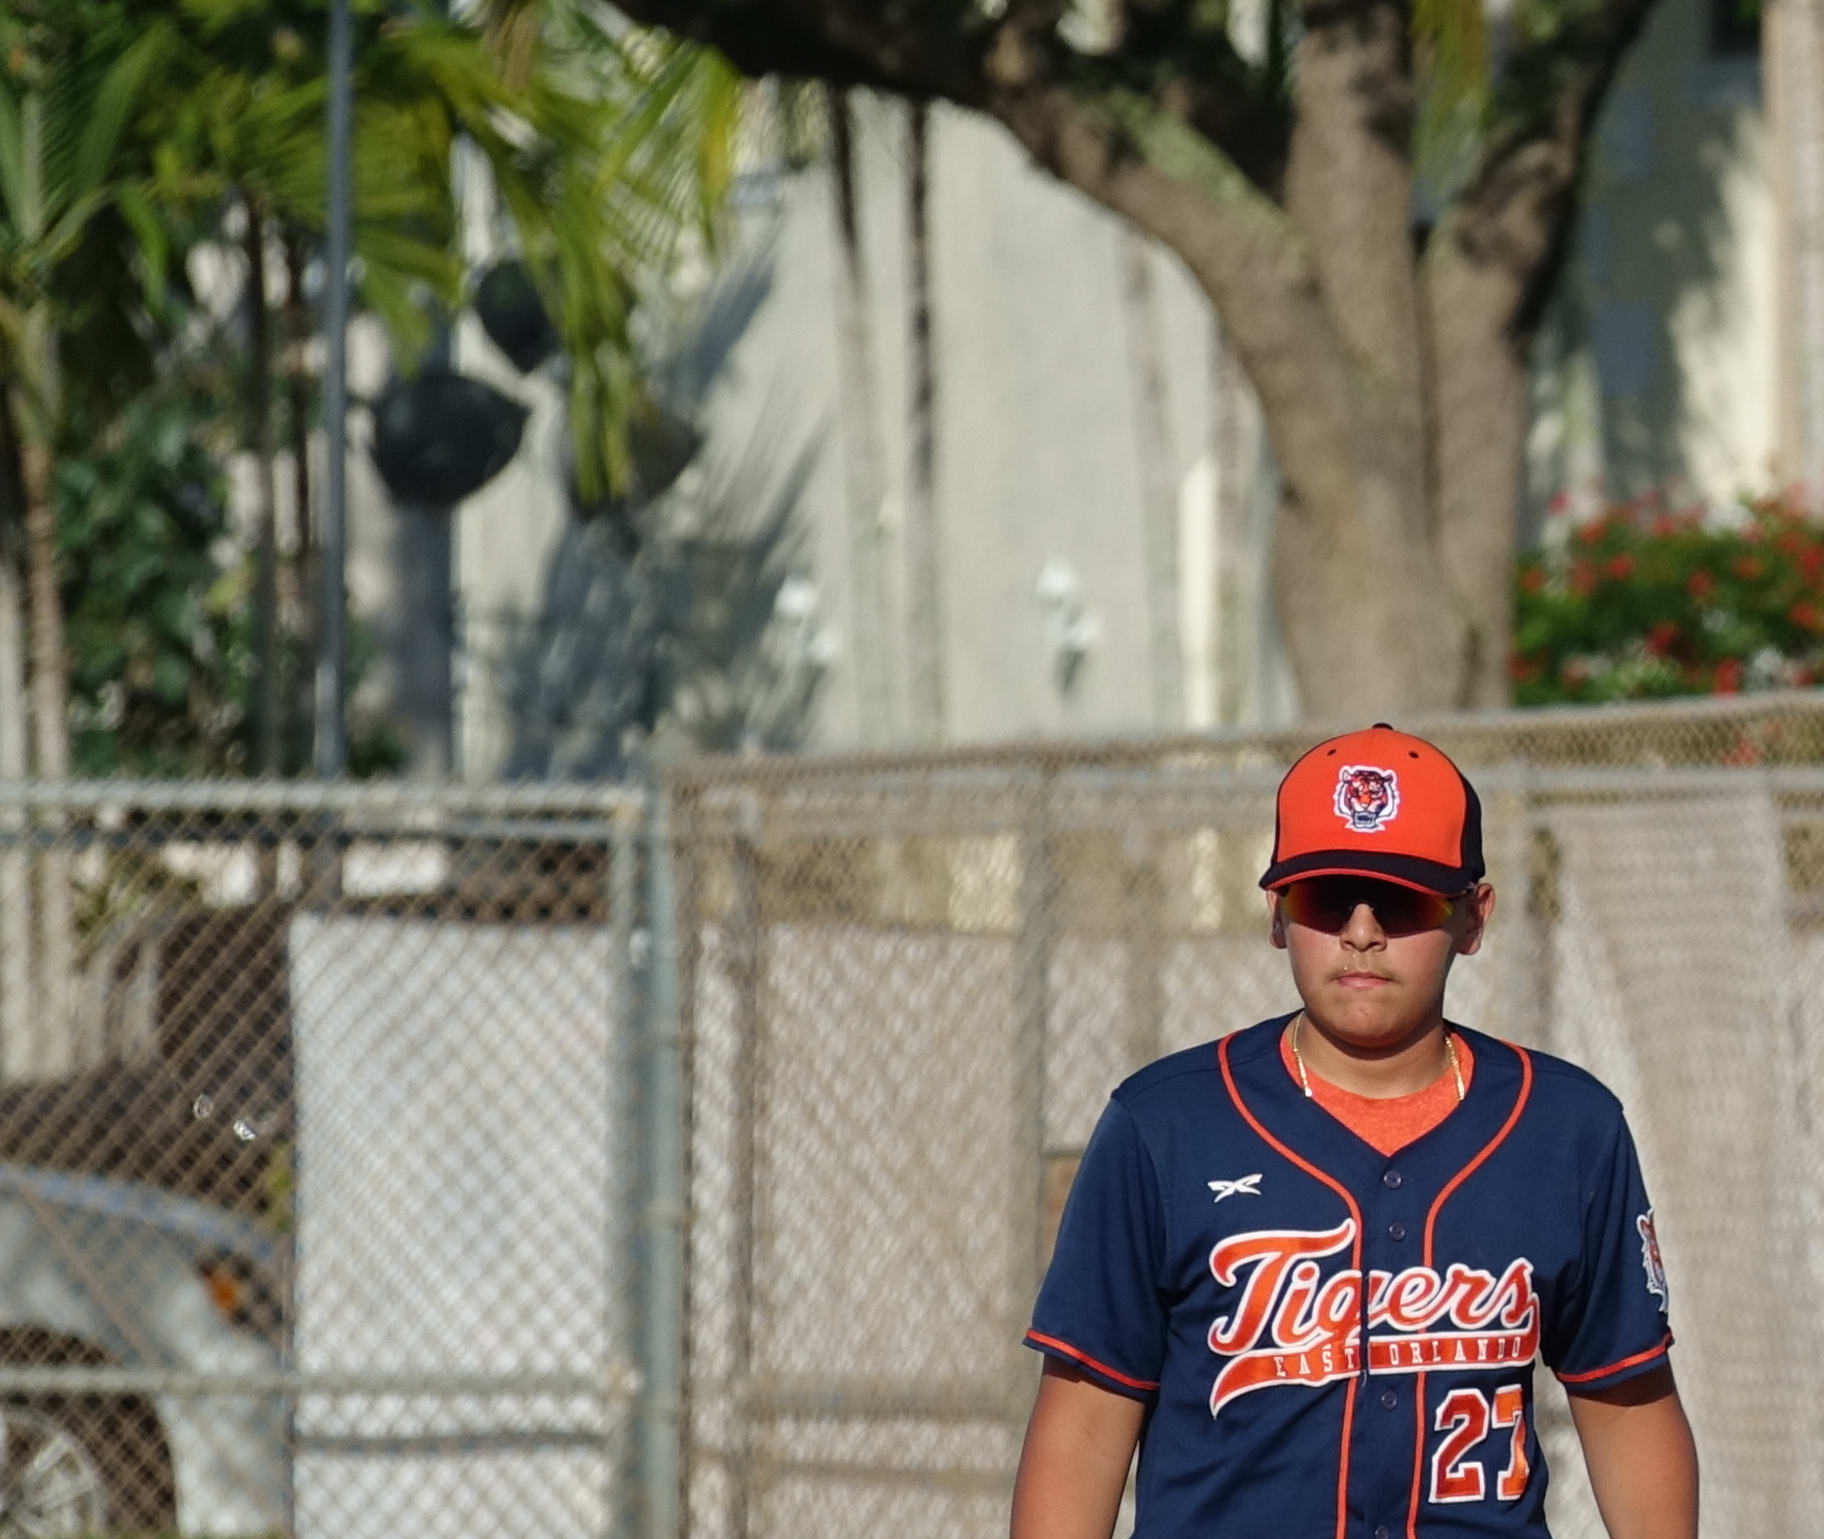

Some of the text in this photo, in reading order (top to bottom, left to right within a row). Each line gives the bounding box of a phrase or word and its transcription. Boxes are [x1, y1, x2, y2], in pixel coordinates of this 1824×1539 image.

[1208, 1217, 1535, 1356] Tigers
[1274, 1336, 1521, 1377] EAST ORLANDO
[1429, 1384, 1530, 1503] 27
